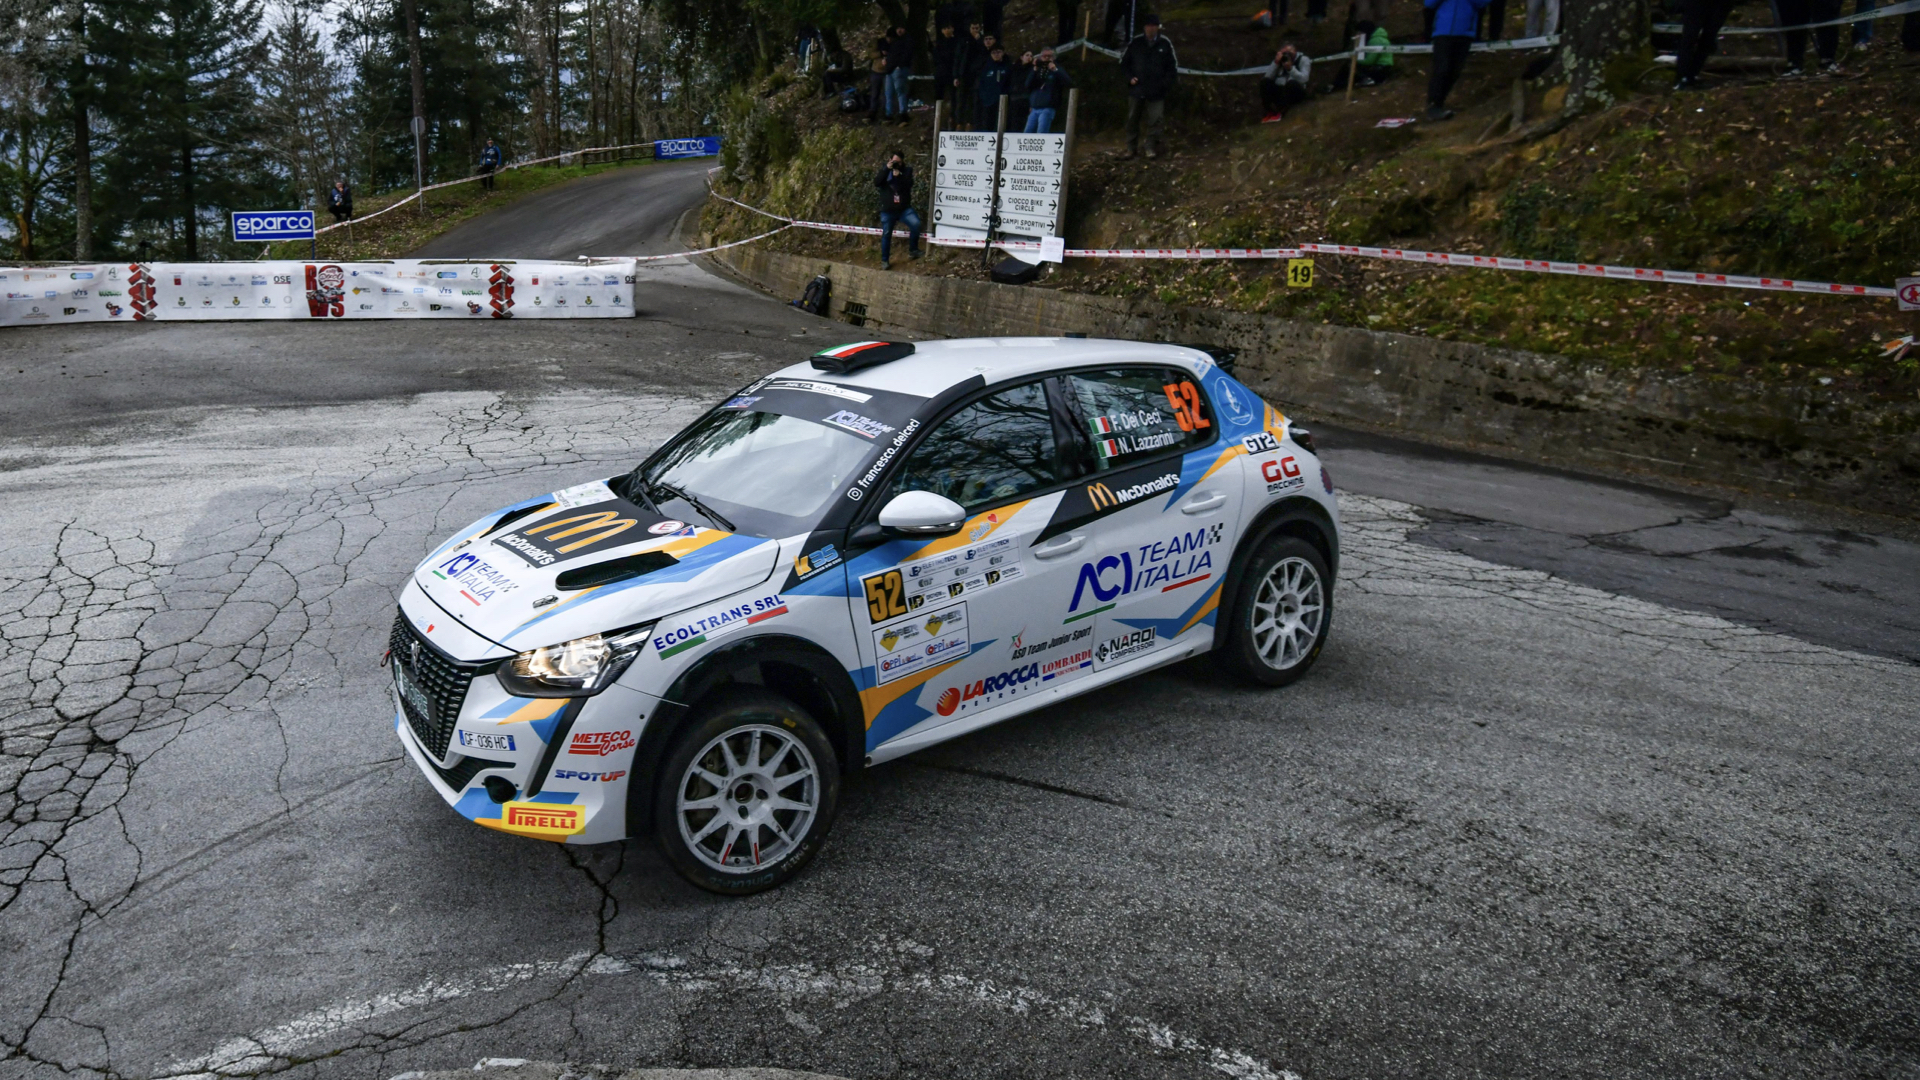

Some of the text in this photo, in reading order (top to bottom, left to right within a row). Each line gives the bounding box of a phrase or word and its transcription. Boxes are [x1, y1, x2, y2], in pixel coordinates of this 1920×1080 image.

[661, 140, 705, 156] sparco
[237, 216, 312, 235] sparco
[1020, 219, 1046, 228] SPORTIVI
[1291, 265, 1310, 283] 19
[826, 410, 859, 426] ACI
[1163, 381, 1210, 432] 52
[1110, 408, 1162, 432] F. Dei Ceci
[1119, 428, 1175, 454] N. Lazzarini
[1261, 456, 1300, 483] GG
[1116, 474, 1180, 503] McDonald's
[1267, 477, 1304, 492] MACCHINE
[500, 534, 556, 565] McDonald's
[439, 552, 510, 587] ACI TEAM
[1068, 528, 1205, 613] ACI TEAM
[1134, 551, 1212, 592] ITALIA
[456, 572, 496, 602] ITALIA
[864, 571, 907, 622] 52
[653, 594, 785, 650] ECOLTRANS SRL
[1011, 626, 1092, 661] ASD Team Junior Sport
[1109, 626, 1156, 651] NARDI
[1110, 641, 1155, 660] COMPRESSORI
[1042, 649, 1091, 674] LOMBARDI
[961, 681, 1038, 710] PETROLI
[572, 730, 631, 744] METECO
[599, 738, 635, 756] Corse
[555, 769, 626, 782] SPOTUP
[508, 807, 577, 829] PIRELLI
